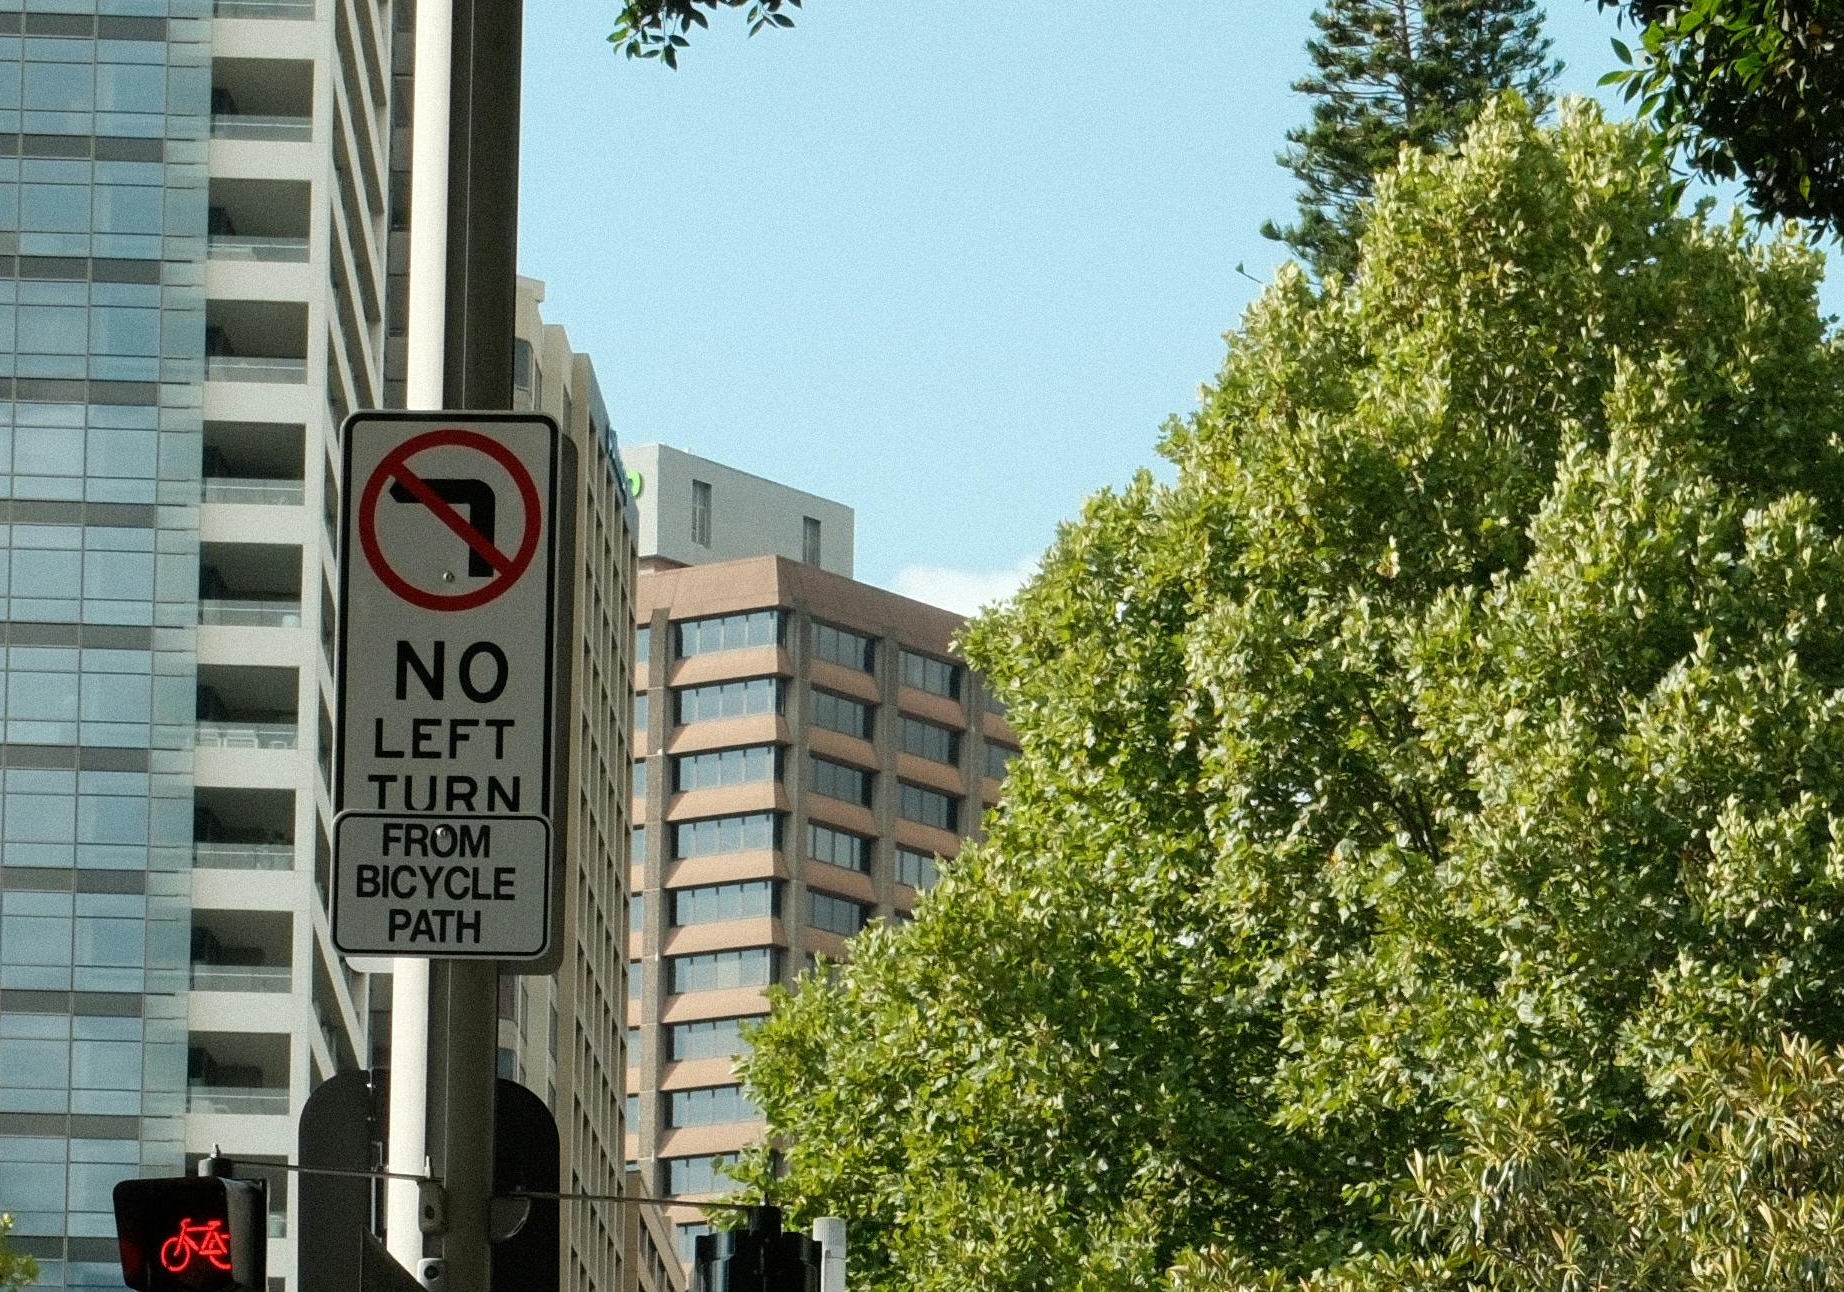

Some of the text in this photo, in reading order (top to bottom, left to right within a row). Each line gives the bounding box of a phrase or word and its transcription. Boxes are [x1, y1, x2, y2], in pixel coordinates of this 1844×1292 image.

[395, 640, 509, 704] NO
[374, 717, 515, 759] LEFT
[367, 774, 521, 813] TURN
[381, 823, 491, 858] FROM
[356, 864, 516, 901] BICYCLE
[387, 908, 482, 944] PATH
